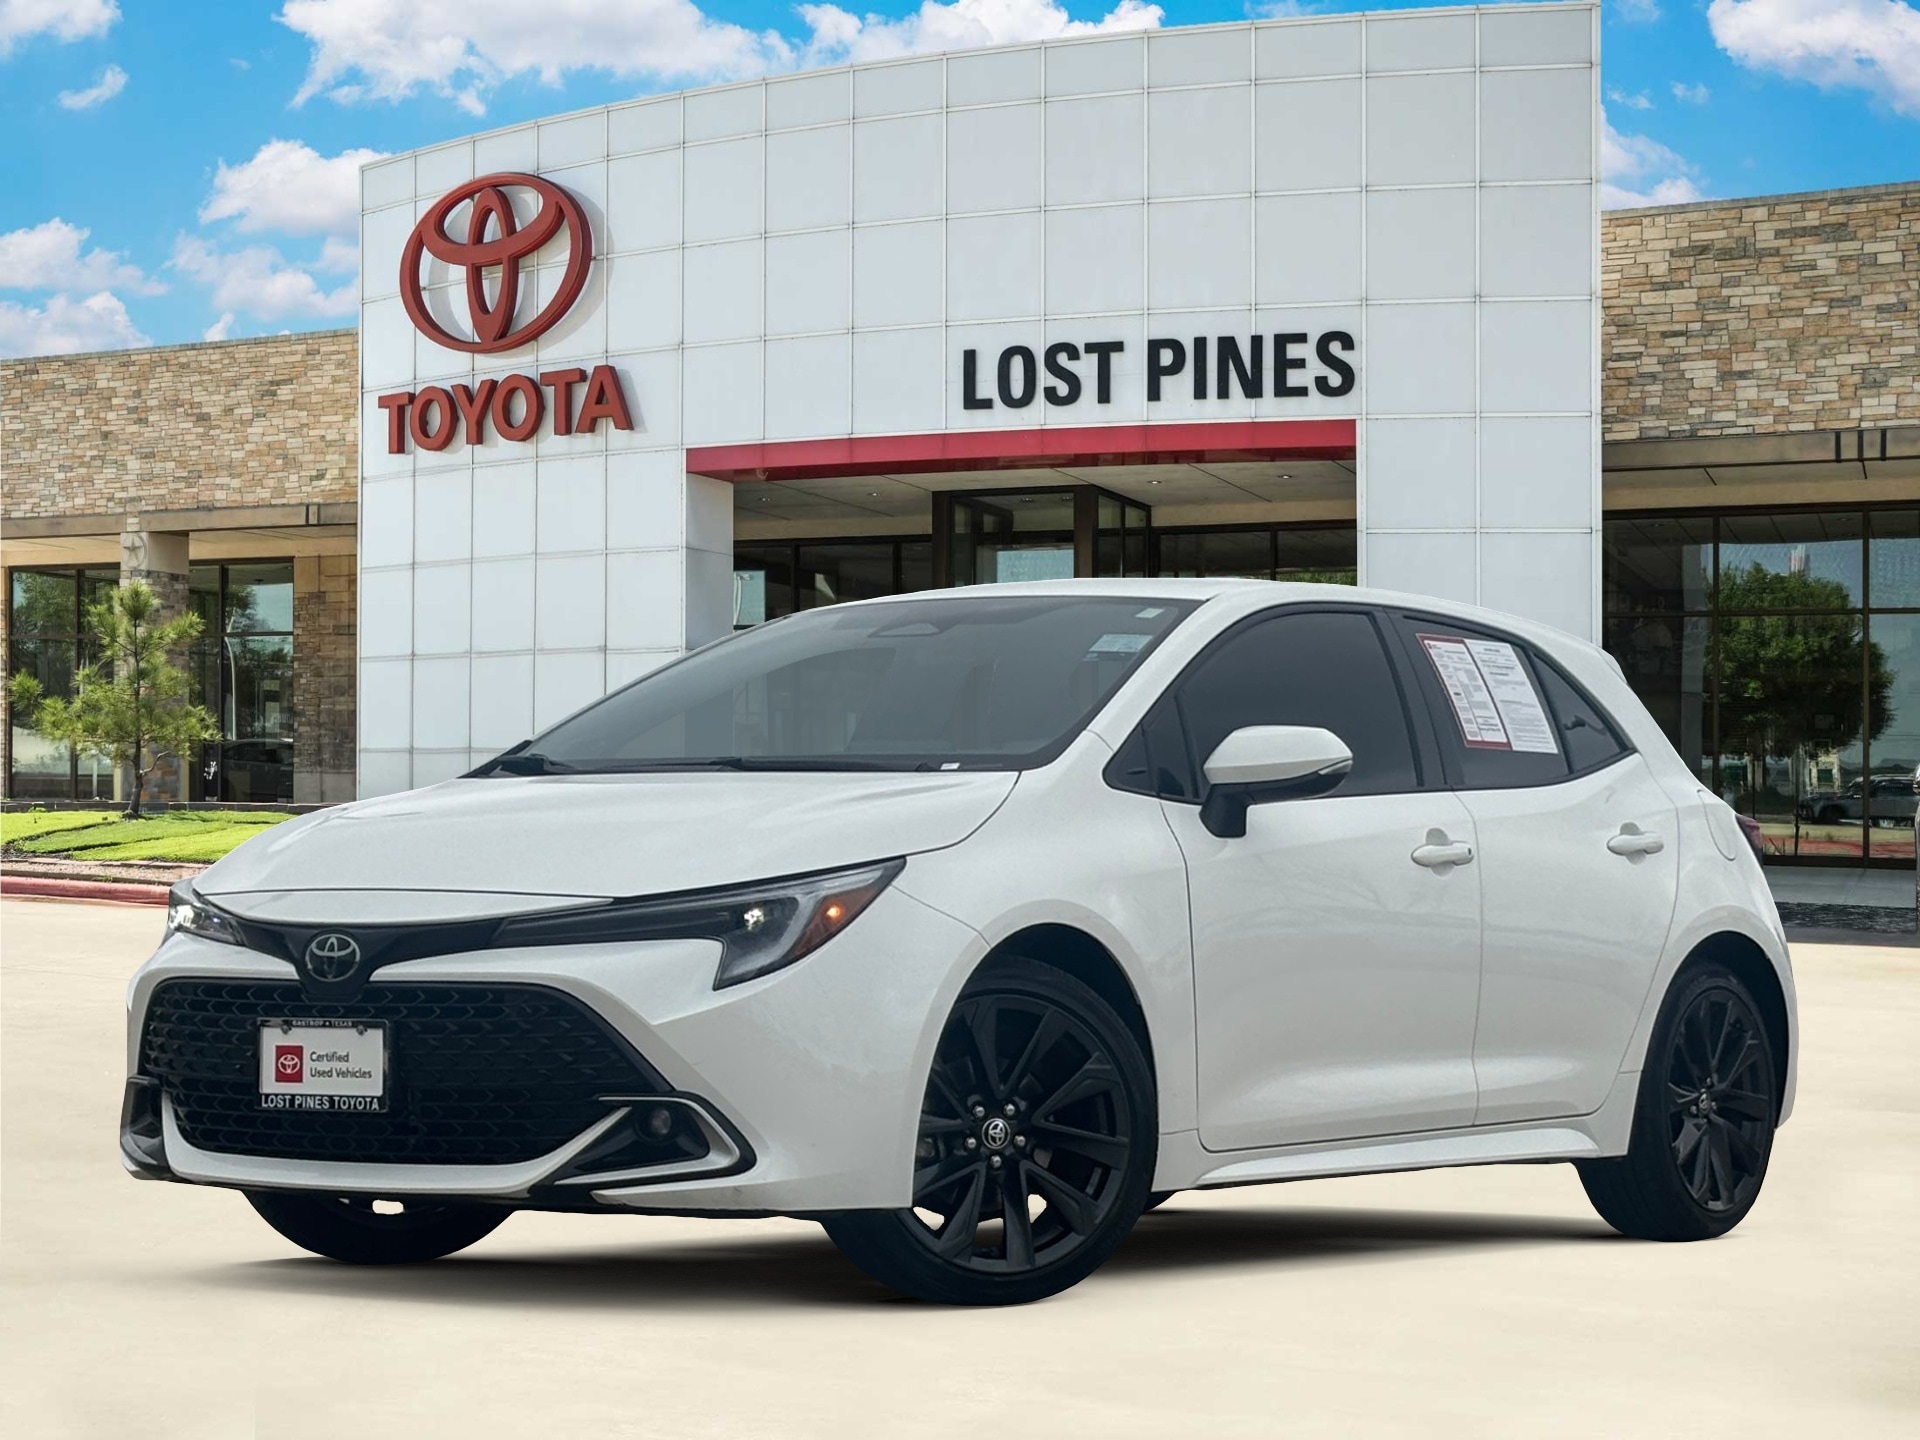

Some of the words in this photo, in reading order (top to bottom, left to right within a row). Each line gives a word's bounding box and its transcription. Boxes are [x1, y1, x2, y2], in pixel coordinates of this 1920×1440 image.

[963, 341, 1124, 410] LOST
[1147, 330, 1355, 402] PINES
[378, 364, 634, 454] TOYOTA
[309, 1051, 350, 1063] Certified
[309, 1067, 333, 1078] Used
[335, 1067, 373, 1079] Vehicles
[261, 1095, 292, 1108] LOST
[294, 1095, 330, 1109] PINES
[332, 1097, 380, 1111] TOYOTA
